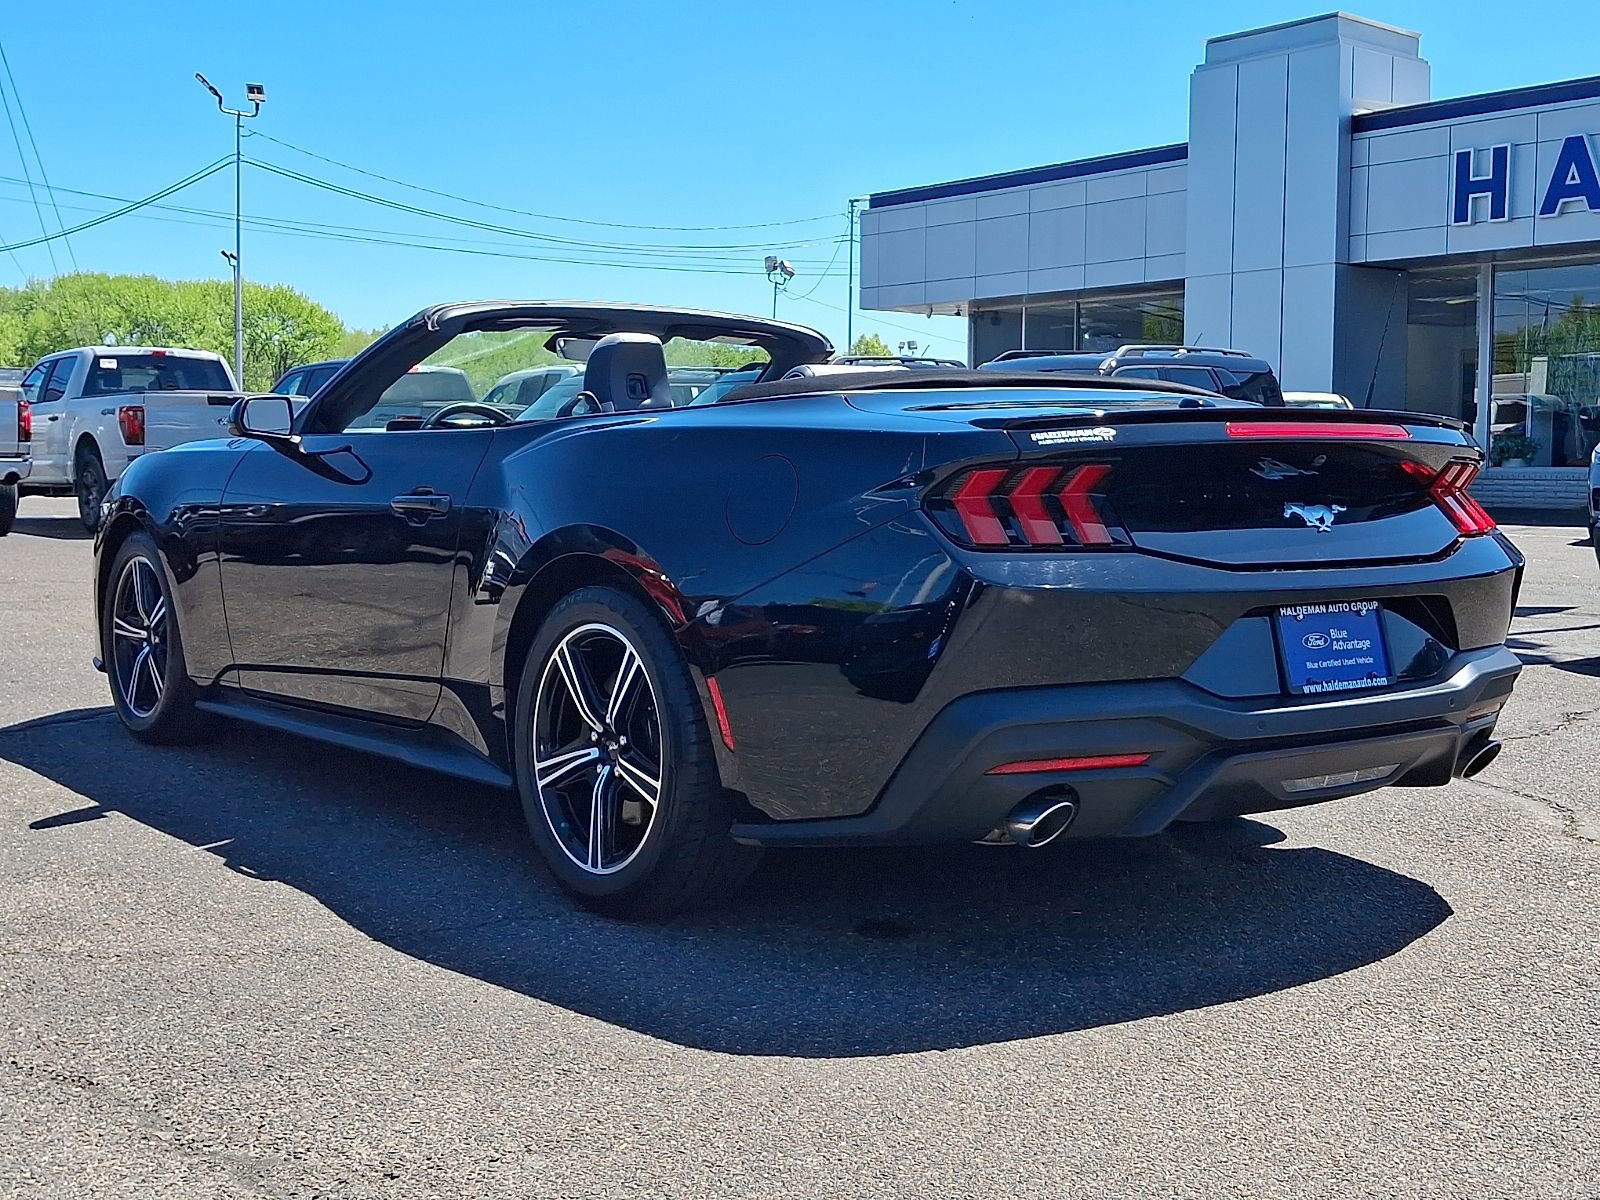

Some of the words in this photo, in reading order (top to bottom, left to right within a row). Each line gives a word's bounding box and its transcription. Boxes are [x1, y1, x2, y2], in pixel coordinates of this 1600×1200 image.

[1452, 134, 1600, 227] HA
[1280, 605, 1326, 616] HALDEMAN
[1328, 603, 1349, 613] AUTO
[1351, 601, 1378, 611] GROUP
[1329, 628, 1348, 639] Blue
[1332, 639, 1371, 651] Advantage
[1306, 661, 1319, 669] Blue
[1319, 659, 1342, 668] Certified
[1342, 657, 1356, 666] Used
[1356, 656, 1374, 664] Vehicle
[1303, 677, 1388, 694] www.haldemanauto.com
